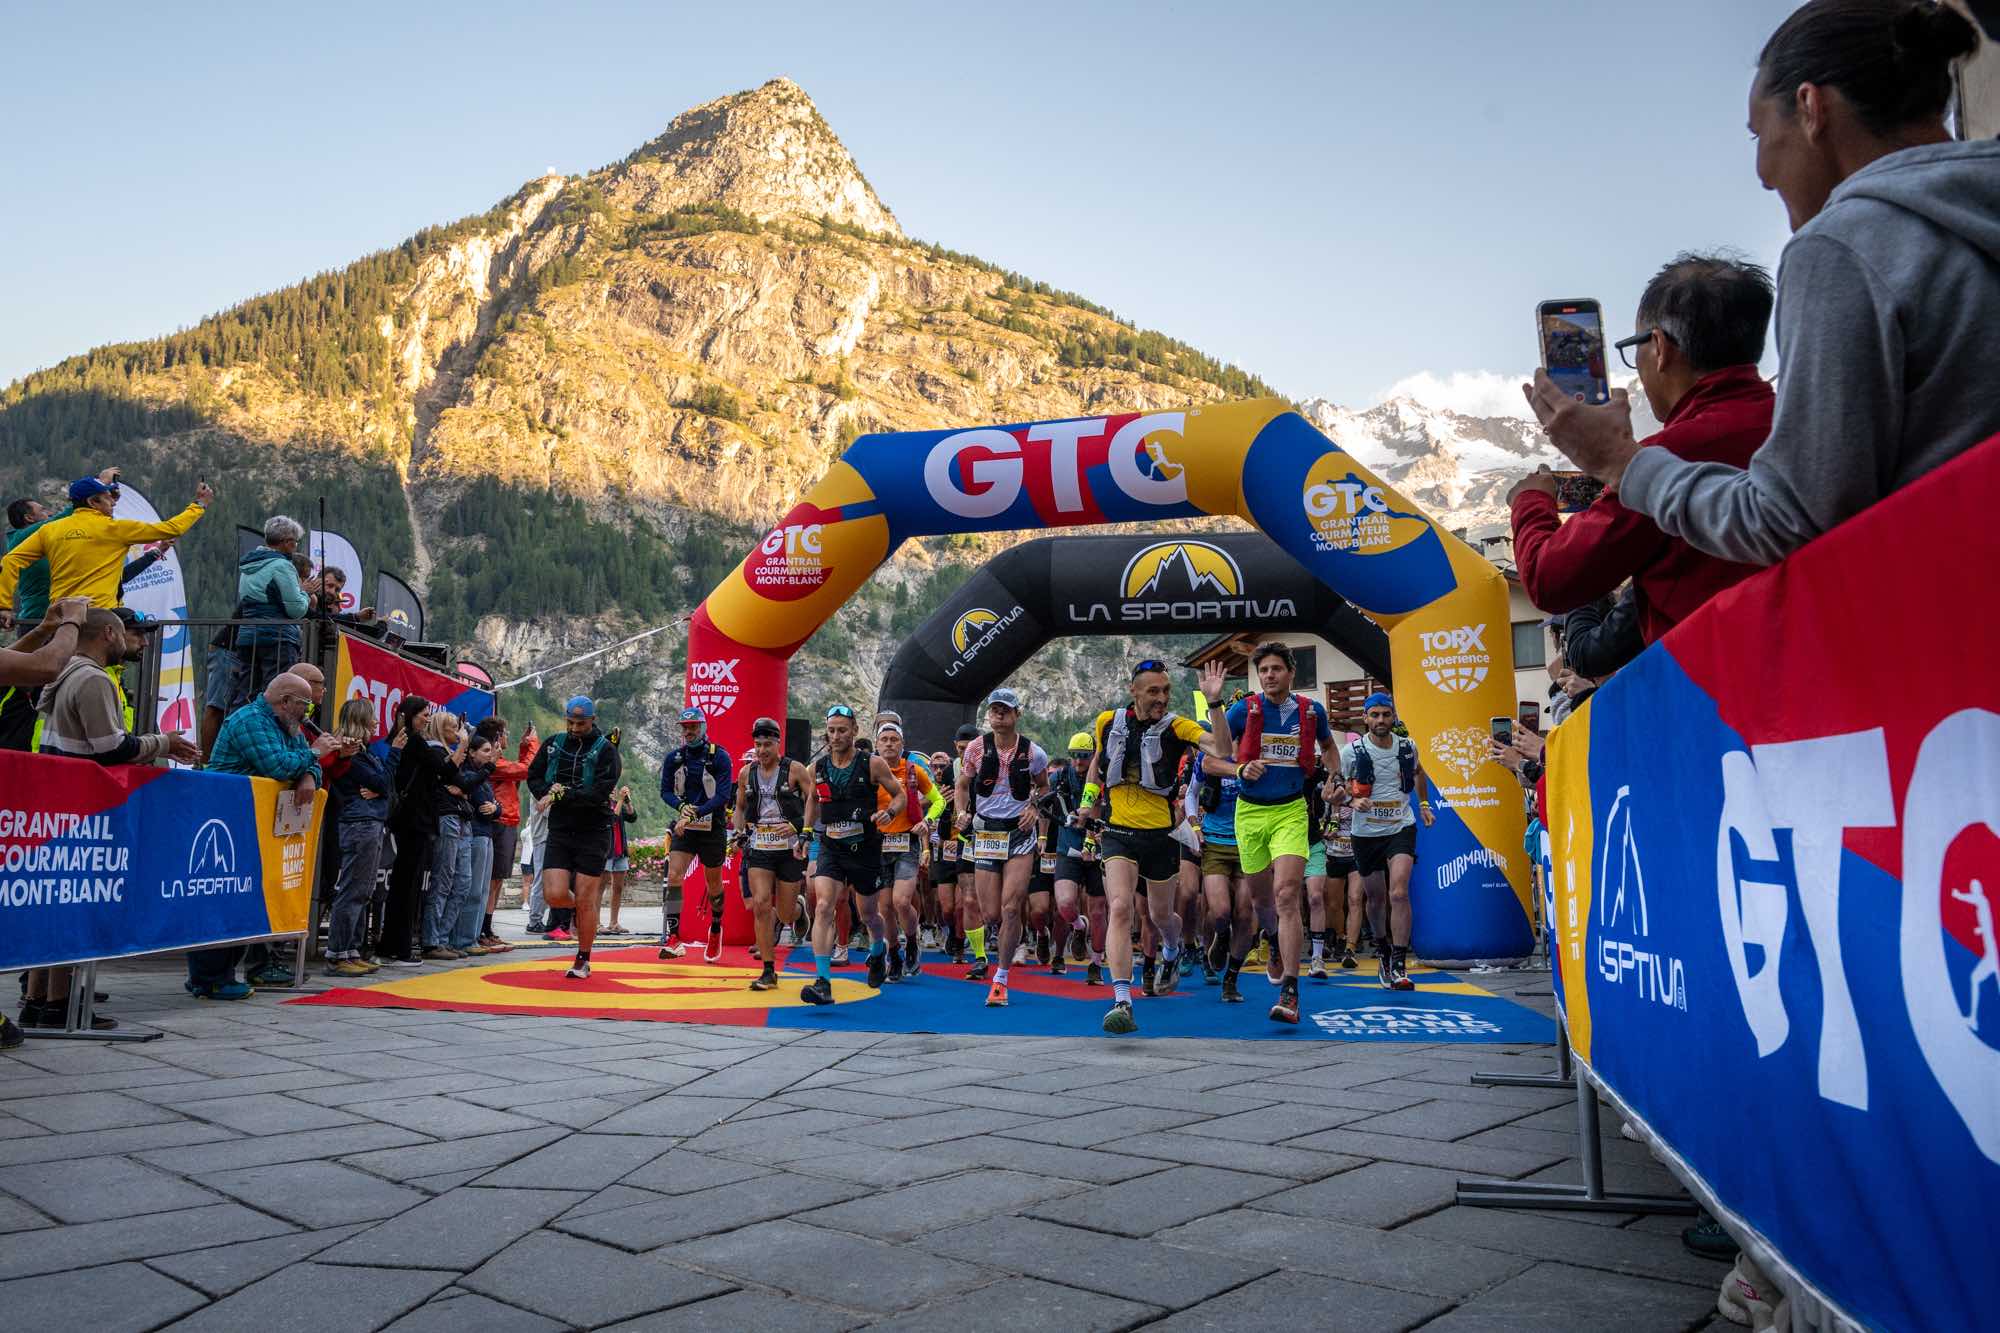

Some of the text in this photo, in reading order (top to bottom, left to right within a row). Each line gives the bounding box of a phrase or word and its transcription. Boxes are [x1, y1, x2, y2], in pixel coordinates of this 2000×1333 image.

[924, 412, 1189, 519] GTC
[1303, 483, 1388, 517] GTC
[1320, 516, 1389, 530] GRANTRAIL
[761, 524, 822, 555] GTC
[1310, 525, 1389, 542] COURMAYEUR
[755, 567, 822, 575] COURMAYEUR
[766, 557, 822, 566] GRANTRAIL
[1069, 603, 1112, 621] LA
[945, 605, 1025, 677] LA SPORTIVA
[1419, 623, 1488, 655] TORX
[691, 659, 741, 684] TORX
[1421, 654, 1490, 669] eXperience
[690, 683, 740, 694] eXperience
[1272, 745, 1296, 757] 1562
[0, 809, 114, 840] GRANTRAIL
[1437, 847, 1508, 890] COURMAYEUR
[161, 876, 253, 898] LA SPORTIVA
[1311, 1013, 1476, 1021] MONT
